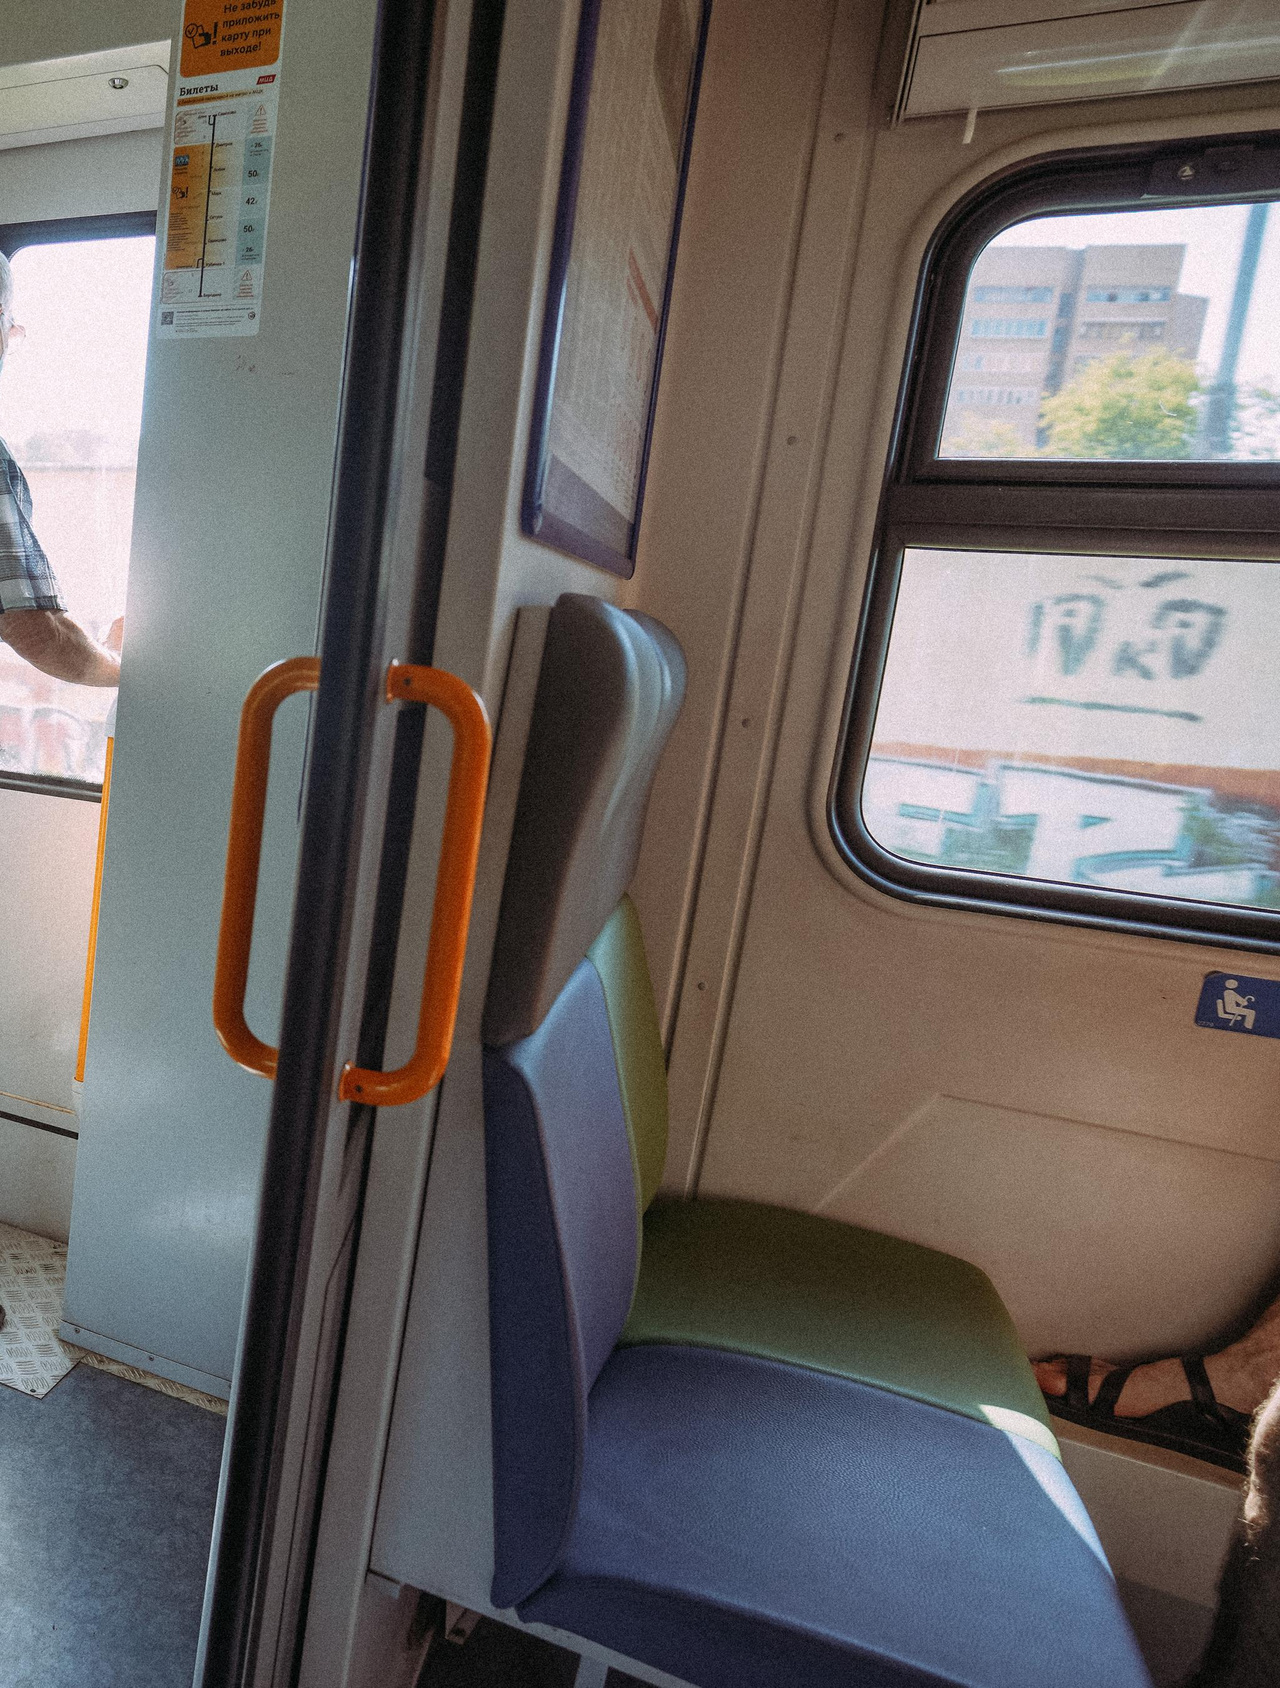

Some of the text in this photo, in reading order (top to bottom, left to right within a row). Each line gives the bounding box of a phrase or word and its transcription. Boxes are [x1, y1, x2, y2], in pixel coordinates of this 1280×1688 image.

[223, 4, 238, 13] Не
[222, 11, 280, 29] приложить
[221, 28, 272, 42] карту при
[220, 41, 262, 57] выходе!
[179, 84, 219, 97] Билеты
